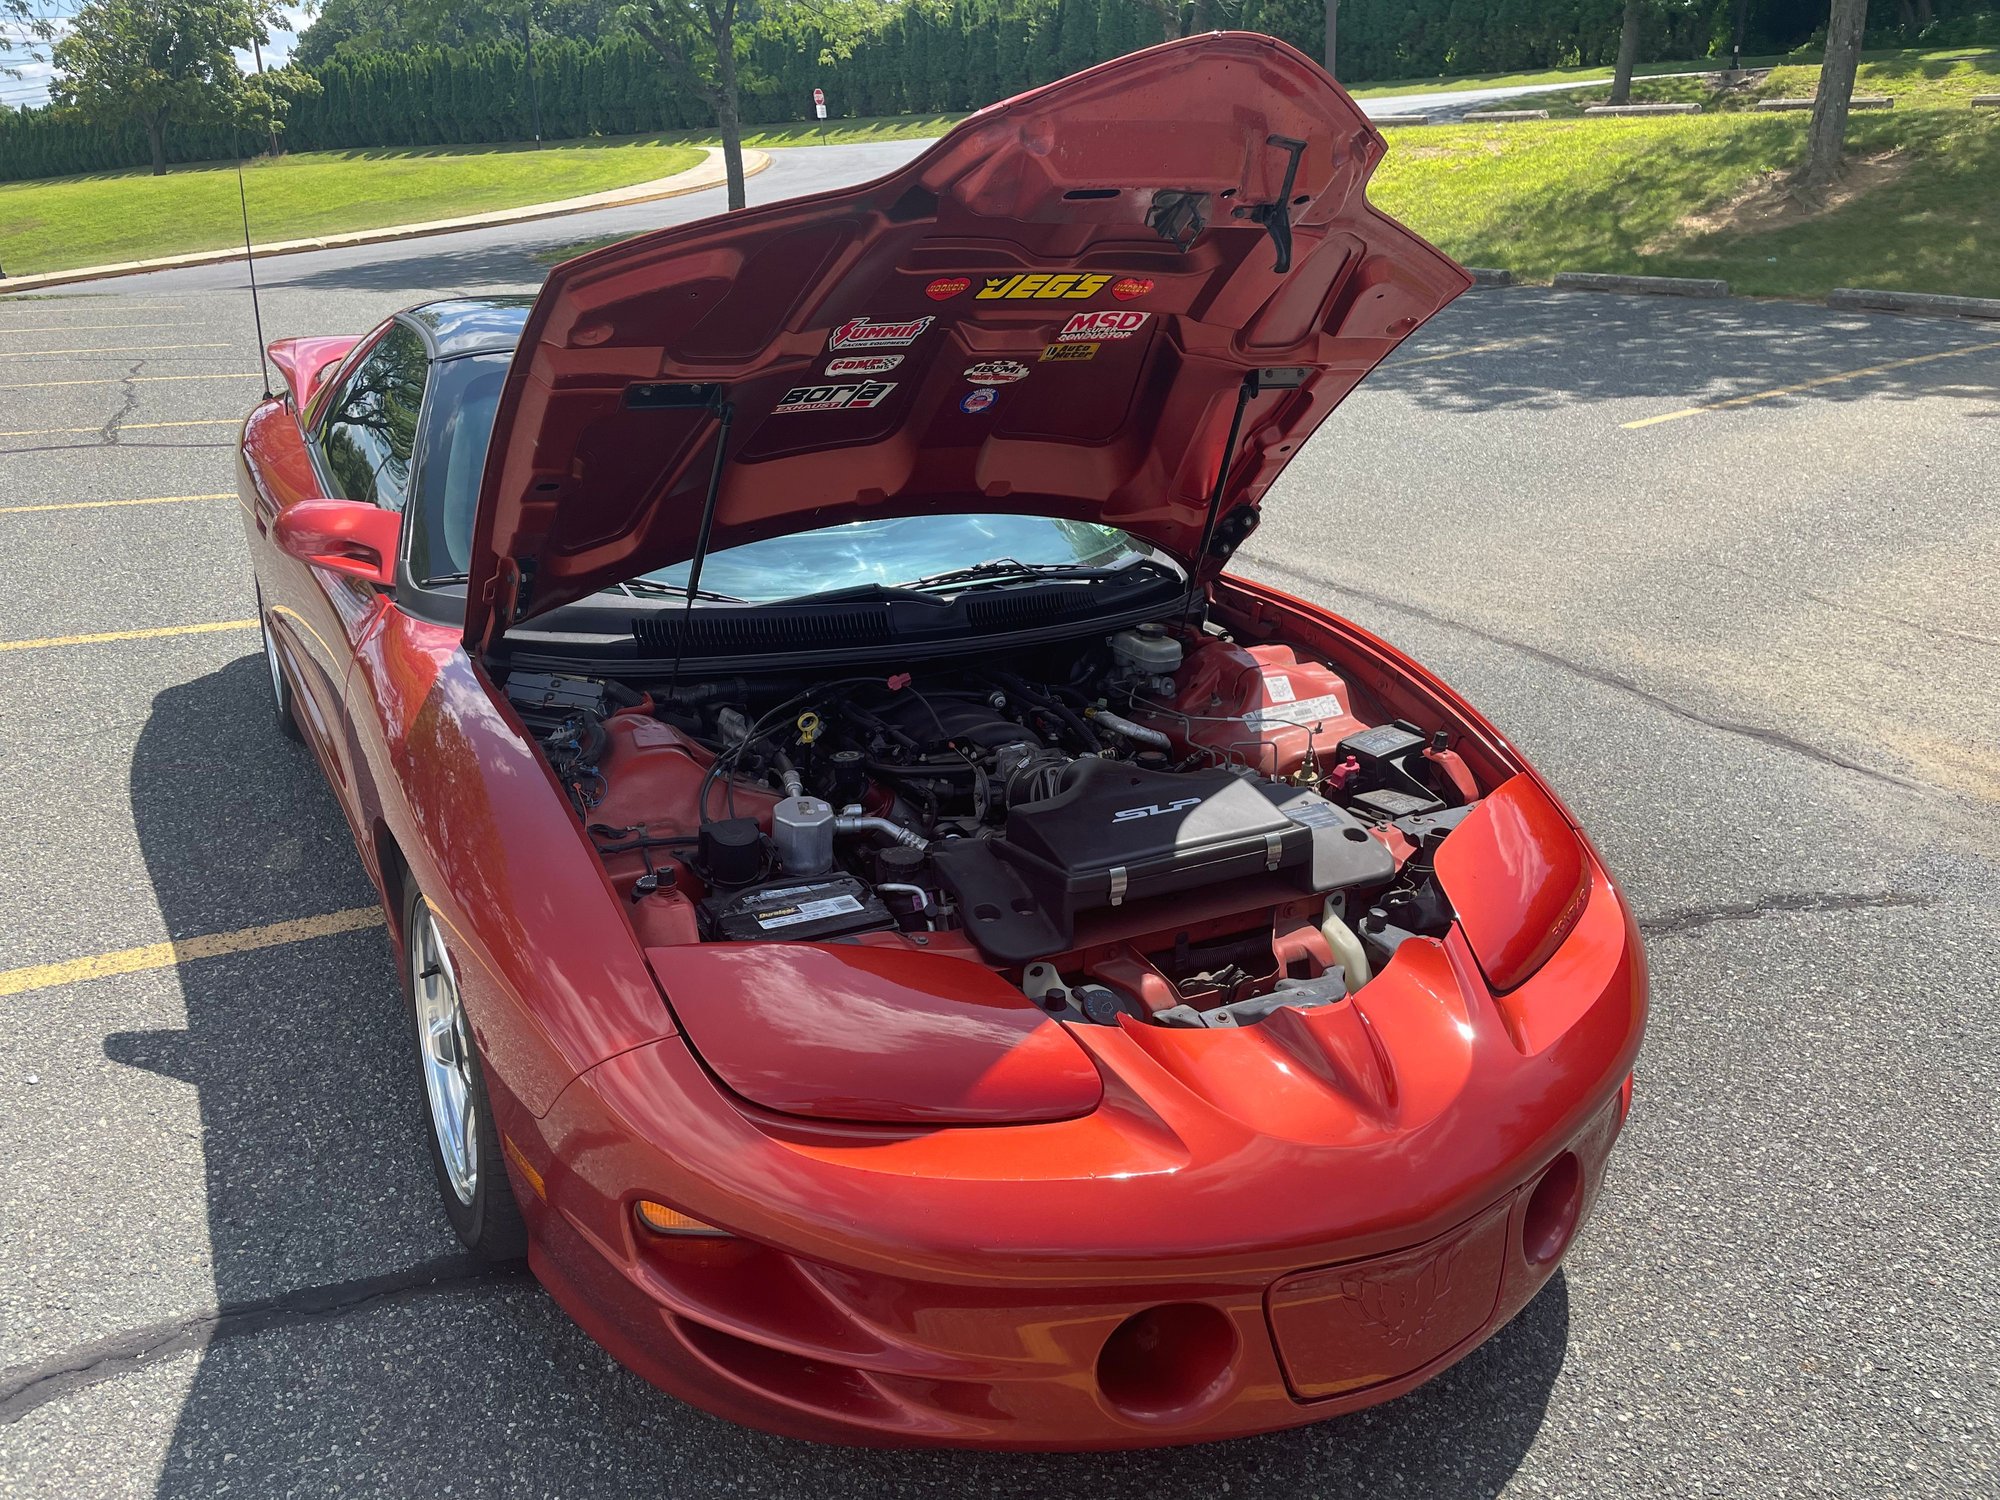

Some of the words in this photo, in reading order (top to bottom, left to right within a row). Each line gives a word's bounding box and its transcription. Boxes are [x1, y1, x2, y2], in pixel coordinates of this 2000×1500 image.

[976, 273, 1113, 299] JEG'S
[1065, 312, 1143, 332] MSD
[1059, 331, 1132, 342] CONDUCTOR
[1087, 326, 1118, 334] SUPER
[831, 358, 884, 371] COMP
[775, 402, 840, 412] EXHAUST
[1112, 797, 1202, 823] SLP
